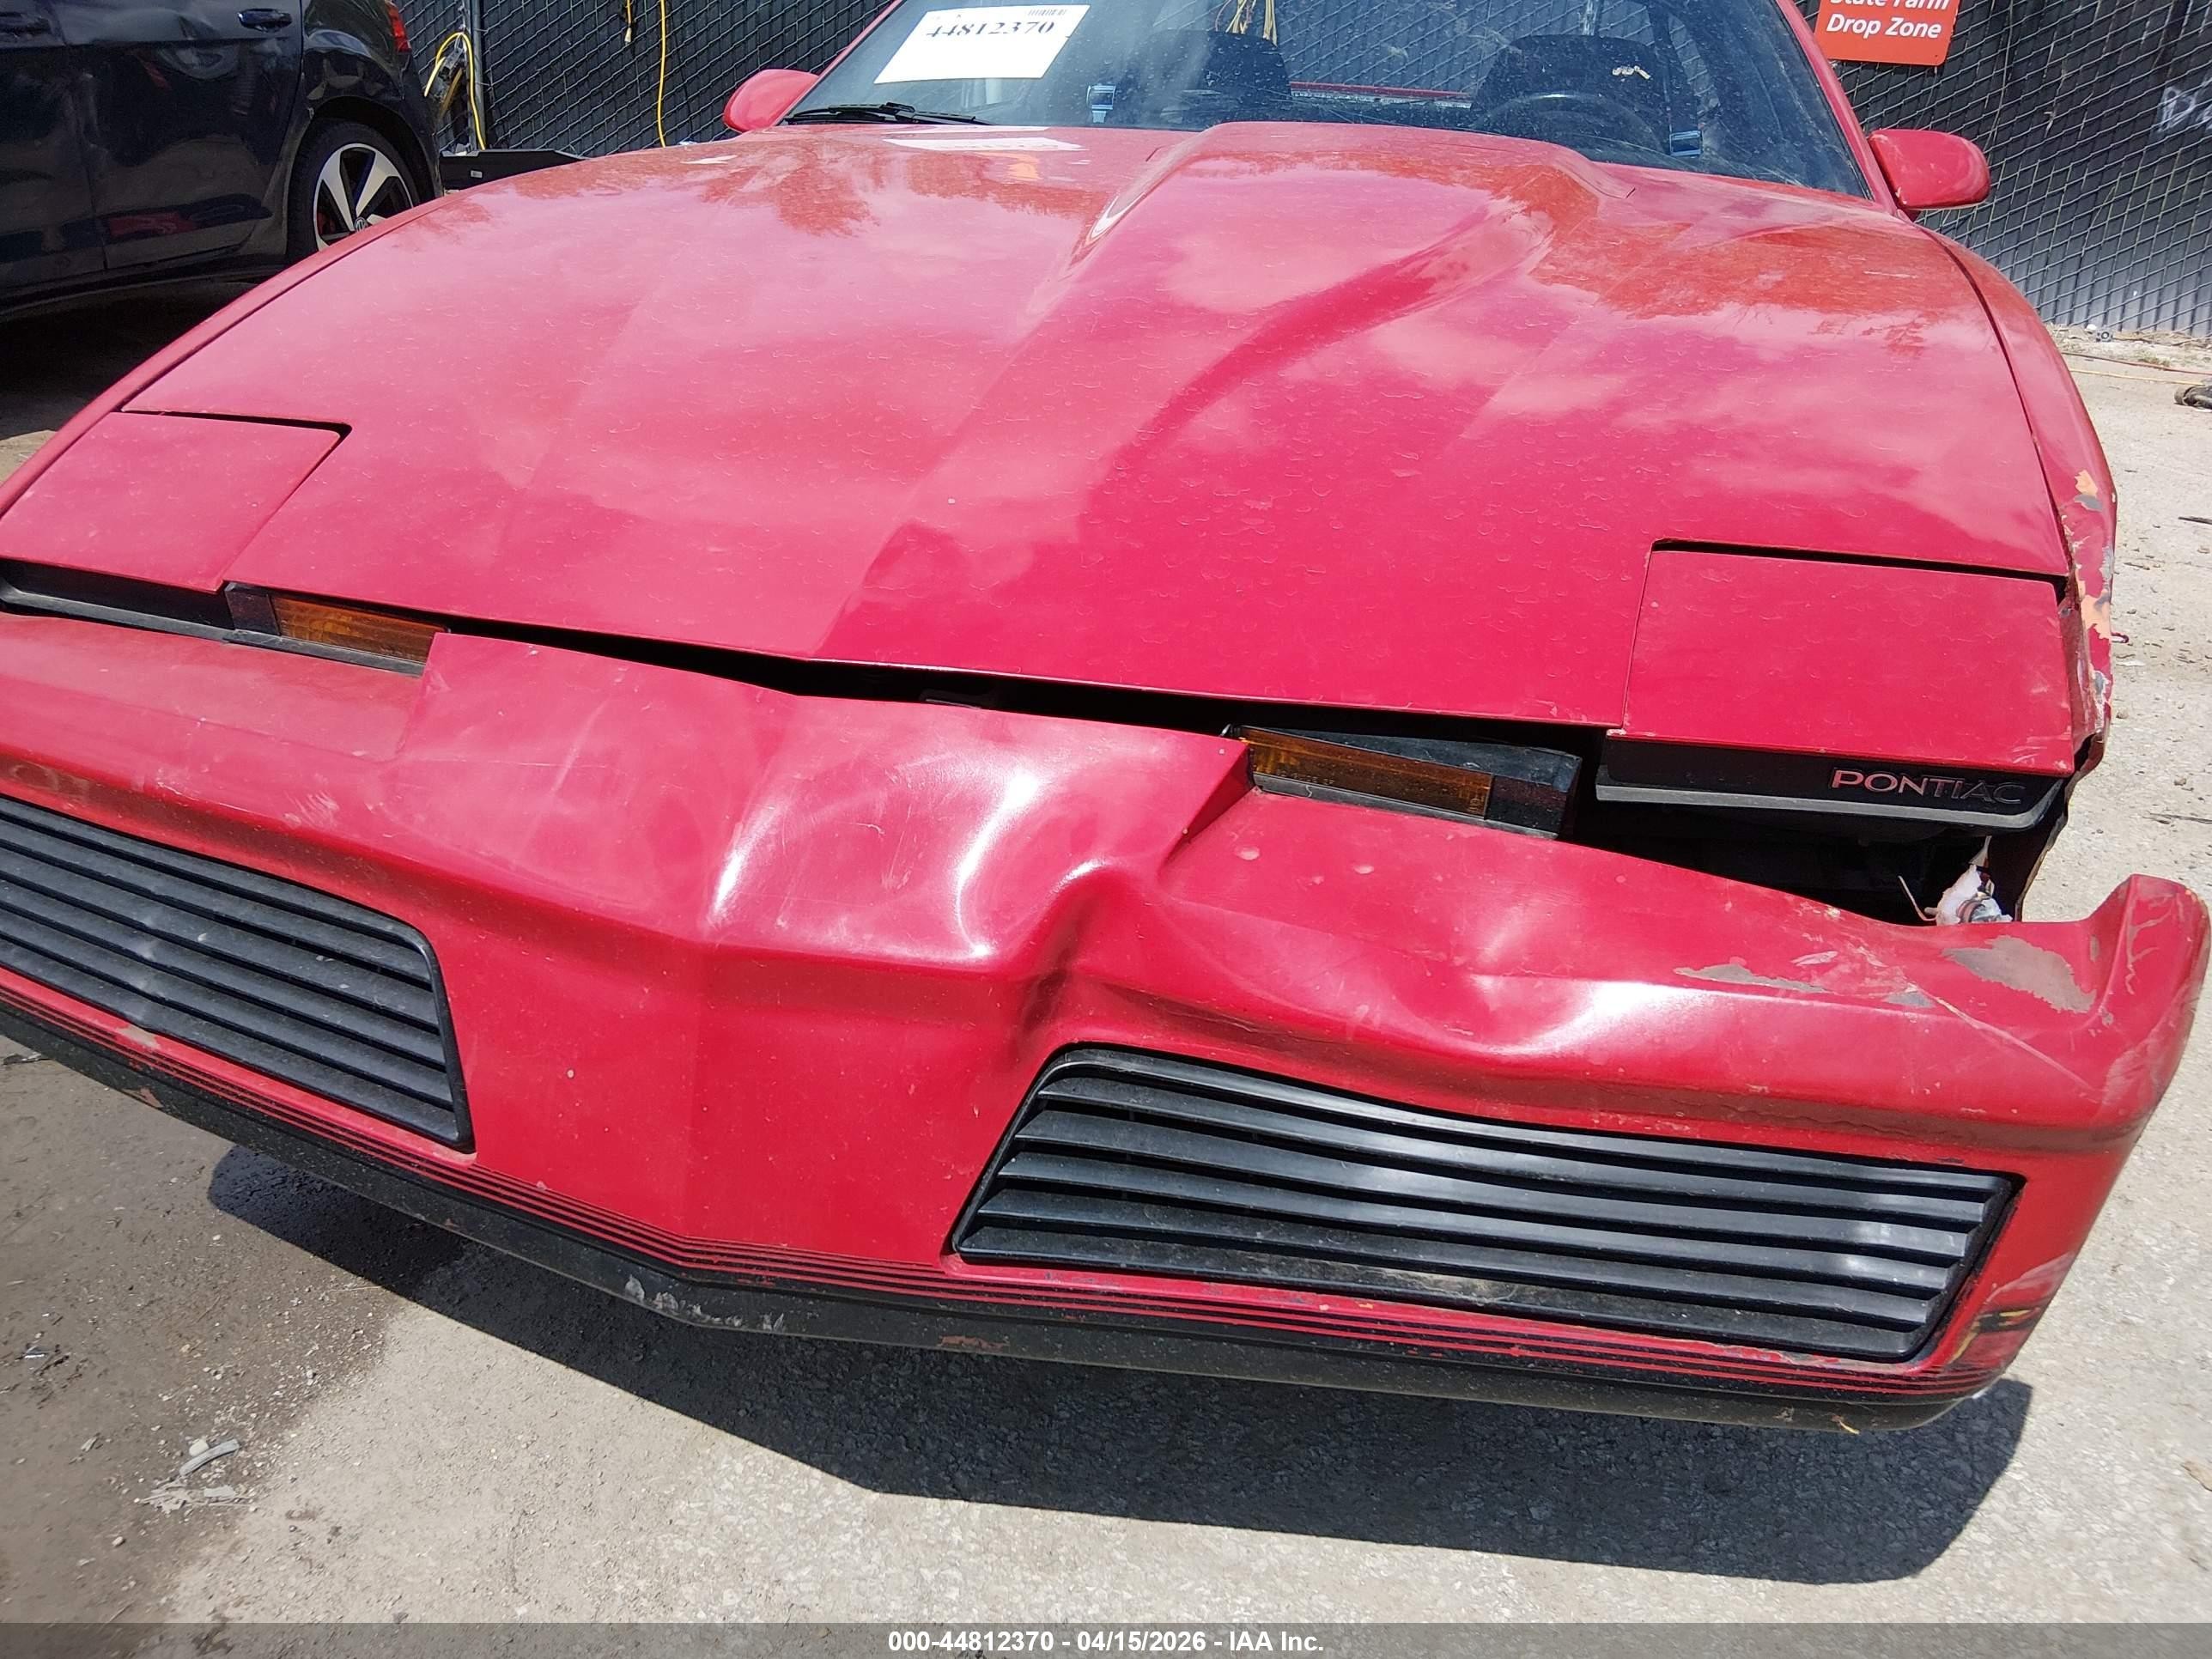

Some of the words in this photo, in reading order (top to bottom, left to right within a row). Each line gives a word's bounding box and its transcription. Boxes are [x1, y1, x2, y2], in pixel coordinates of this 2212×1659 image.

[927, 21, 1054, 37] 44812370
[1826, 13, 1881, 39] Drop
[1884, 17, 1942, 39] Zone
[1831, 769, 2026, 805] PONTIAC
